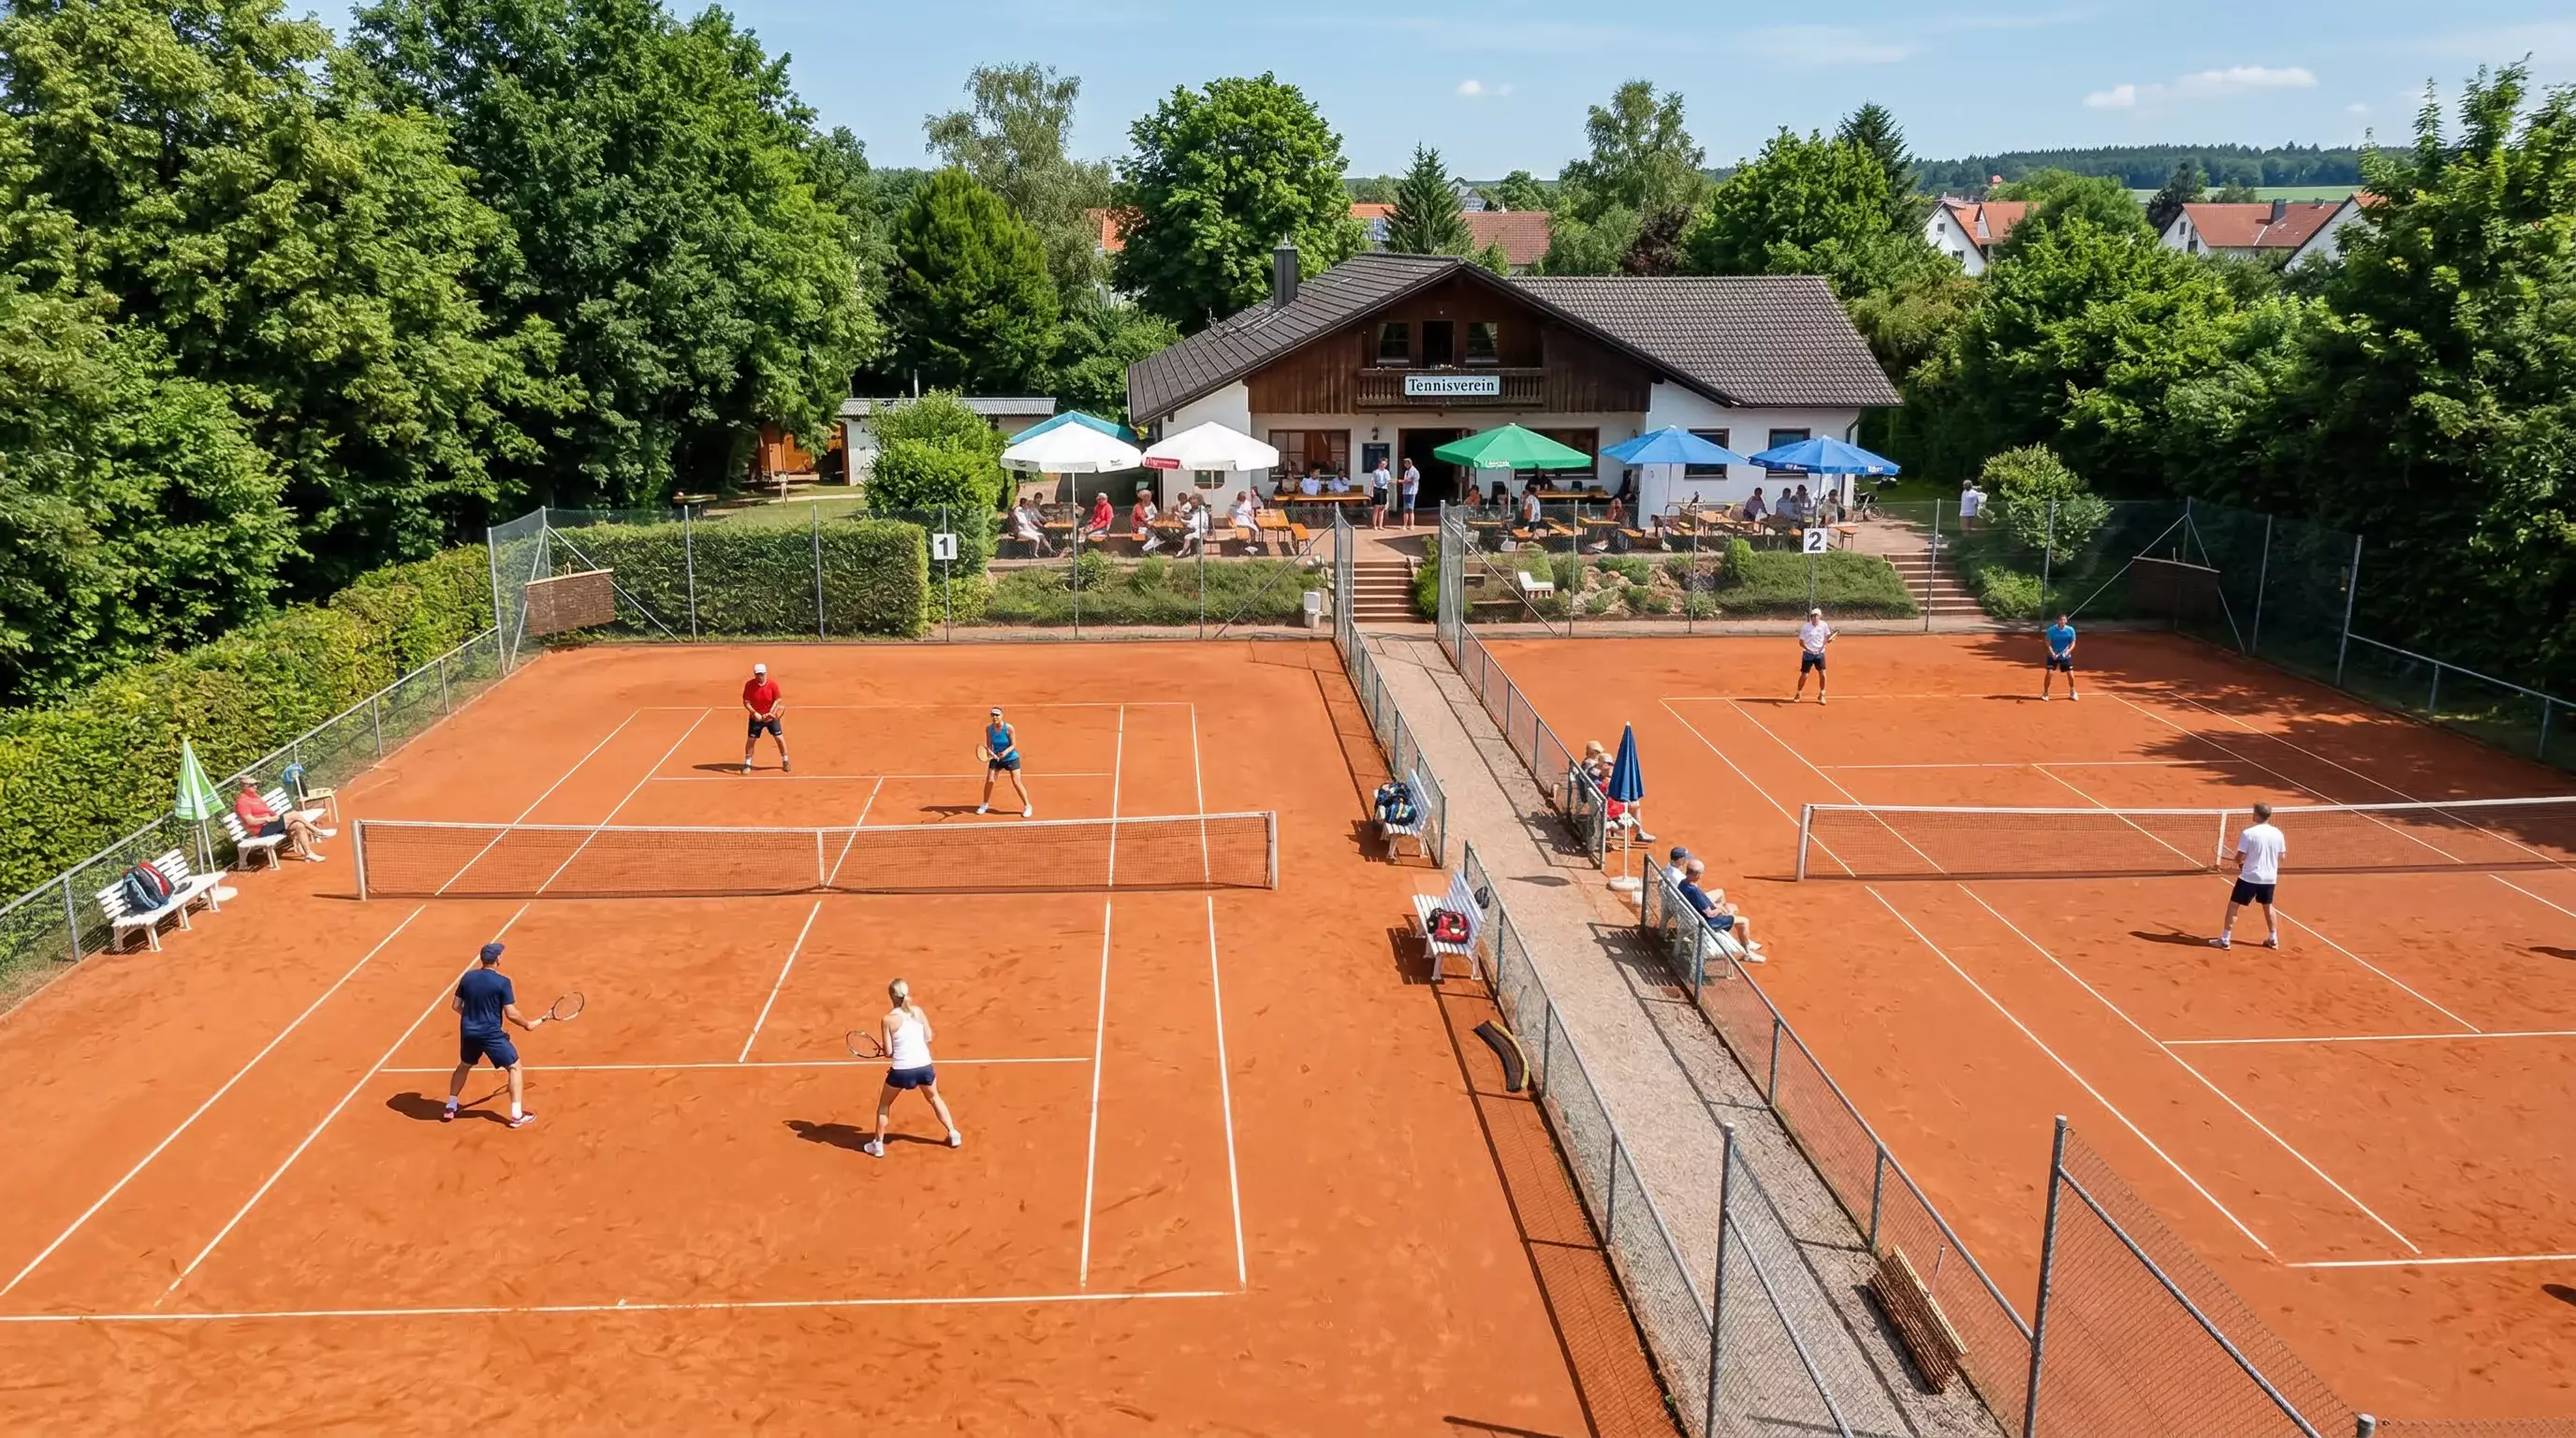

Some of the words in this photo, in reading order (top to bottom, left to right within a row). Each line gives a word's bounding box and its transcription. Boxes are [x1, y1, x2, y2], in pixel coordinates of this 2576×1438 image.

[1408, 378, 1495, 391] Tennisverein
[939, 537, 948, 556] 1
[1808, 532, 1822, 550] 2
